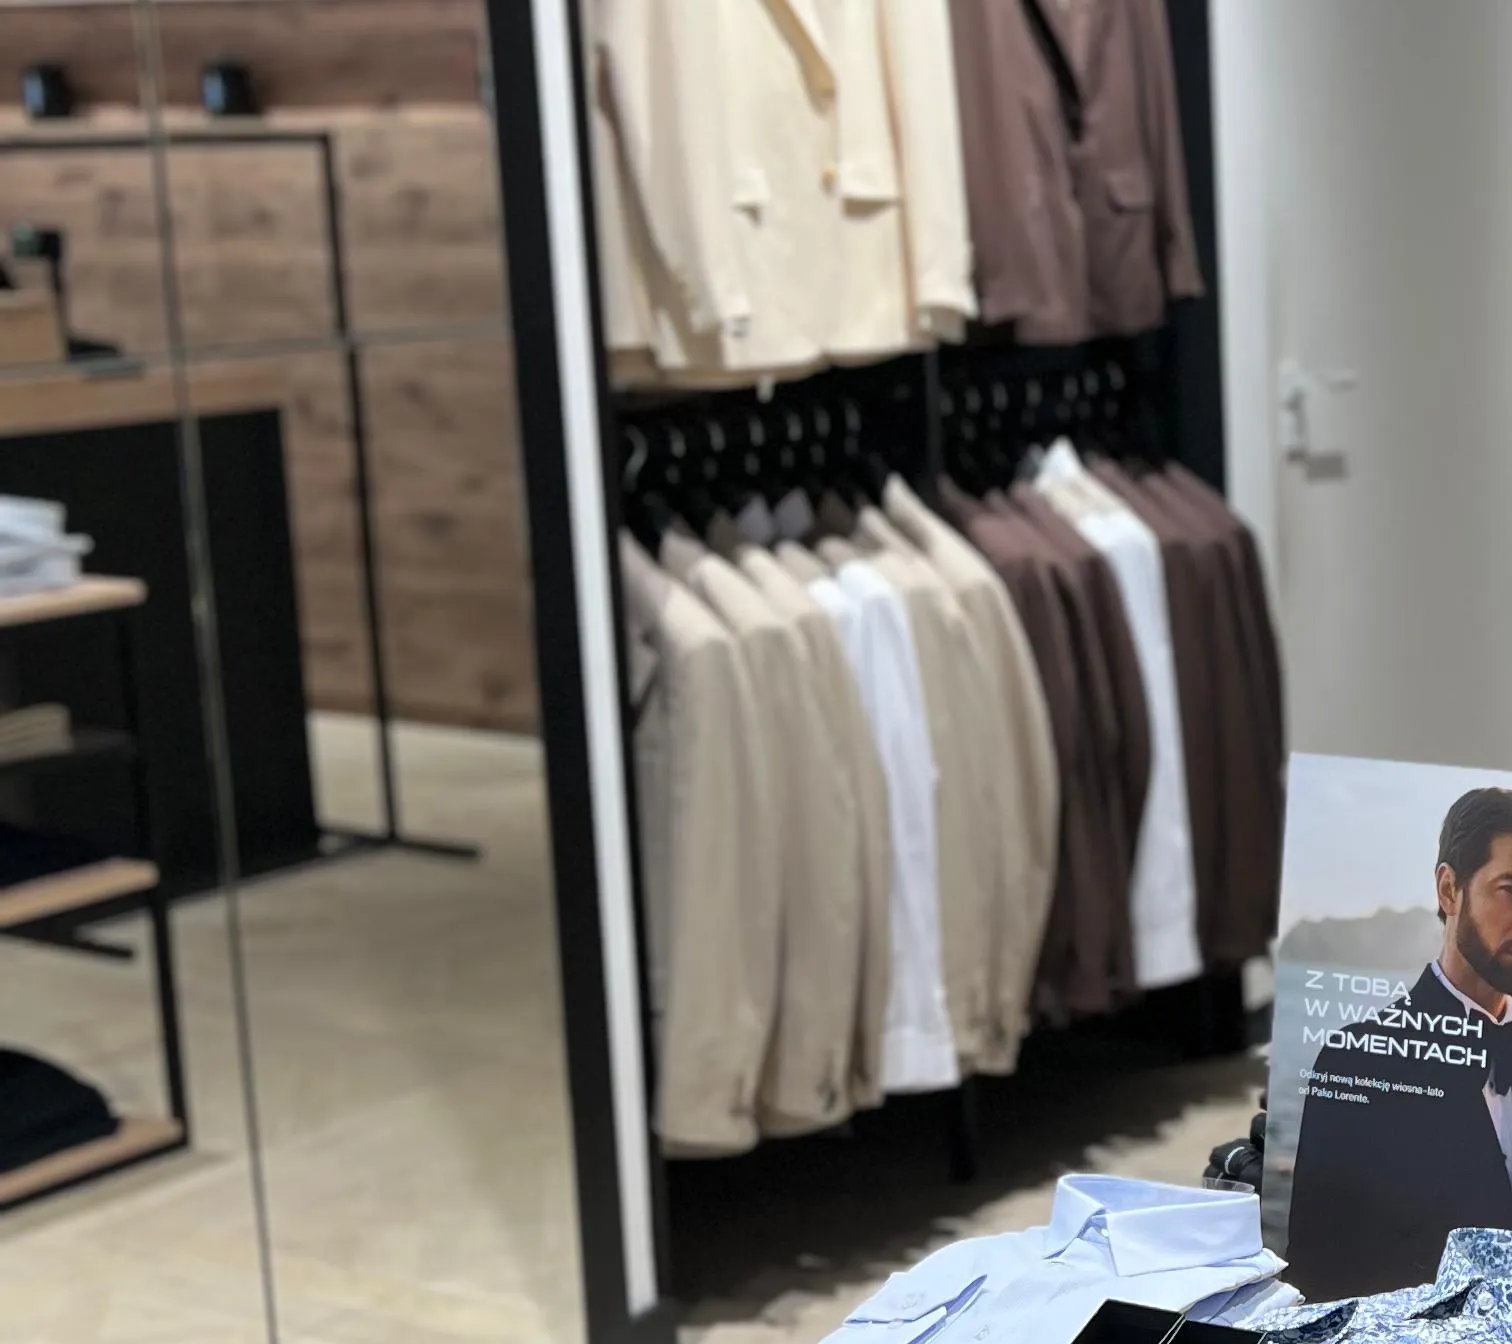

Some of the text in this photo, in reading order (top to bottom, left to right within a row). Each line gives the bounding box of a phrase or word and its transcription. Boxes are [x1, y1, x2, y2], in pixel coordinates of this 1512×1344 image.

[1304, 969, 1412, 1006] Z TOBĄ
[1304, 997, 1484, 1039] W WAŻNYCH
[1302, 1026, 1488, 1069] MOMENTACH
[1311, 1086, 1333, 1099] Pako
